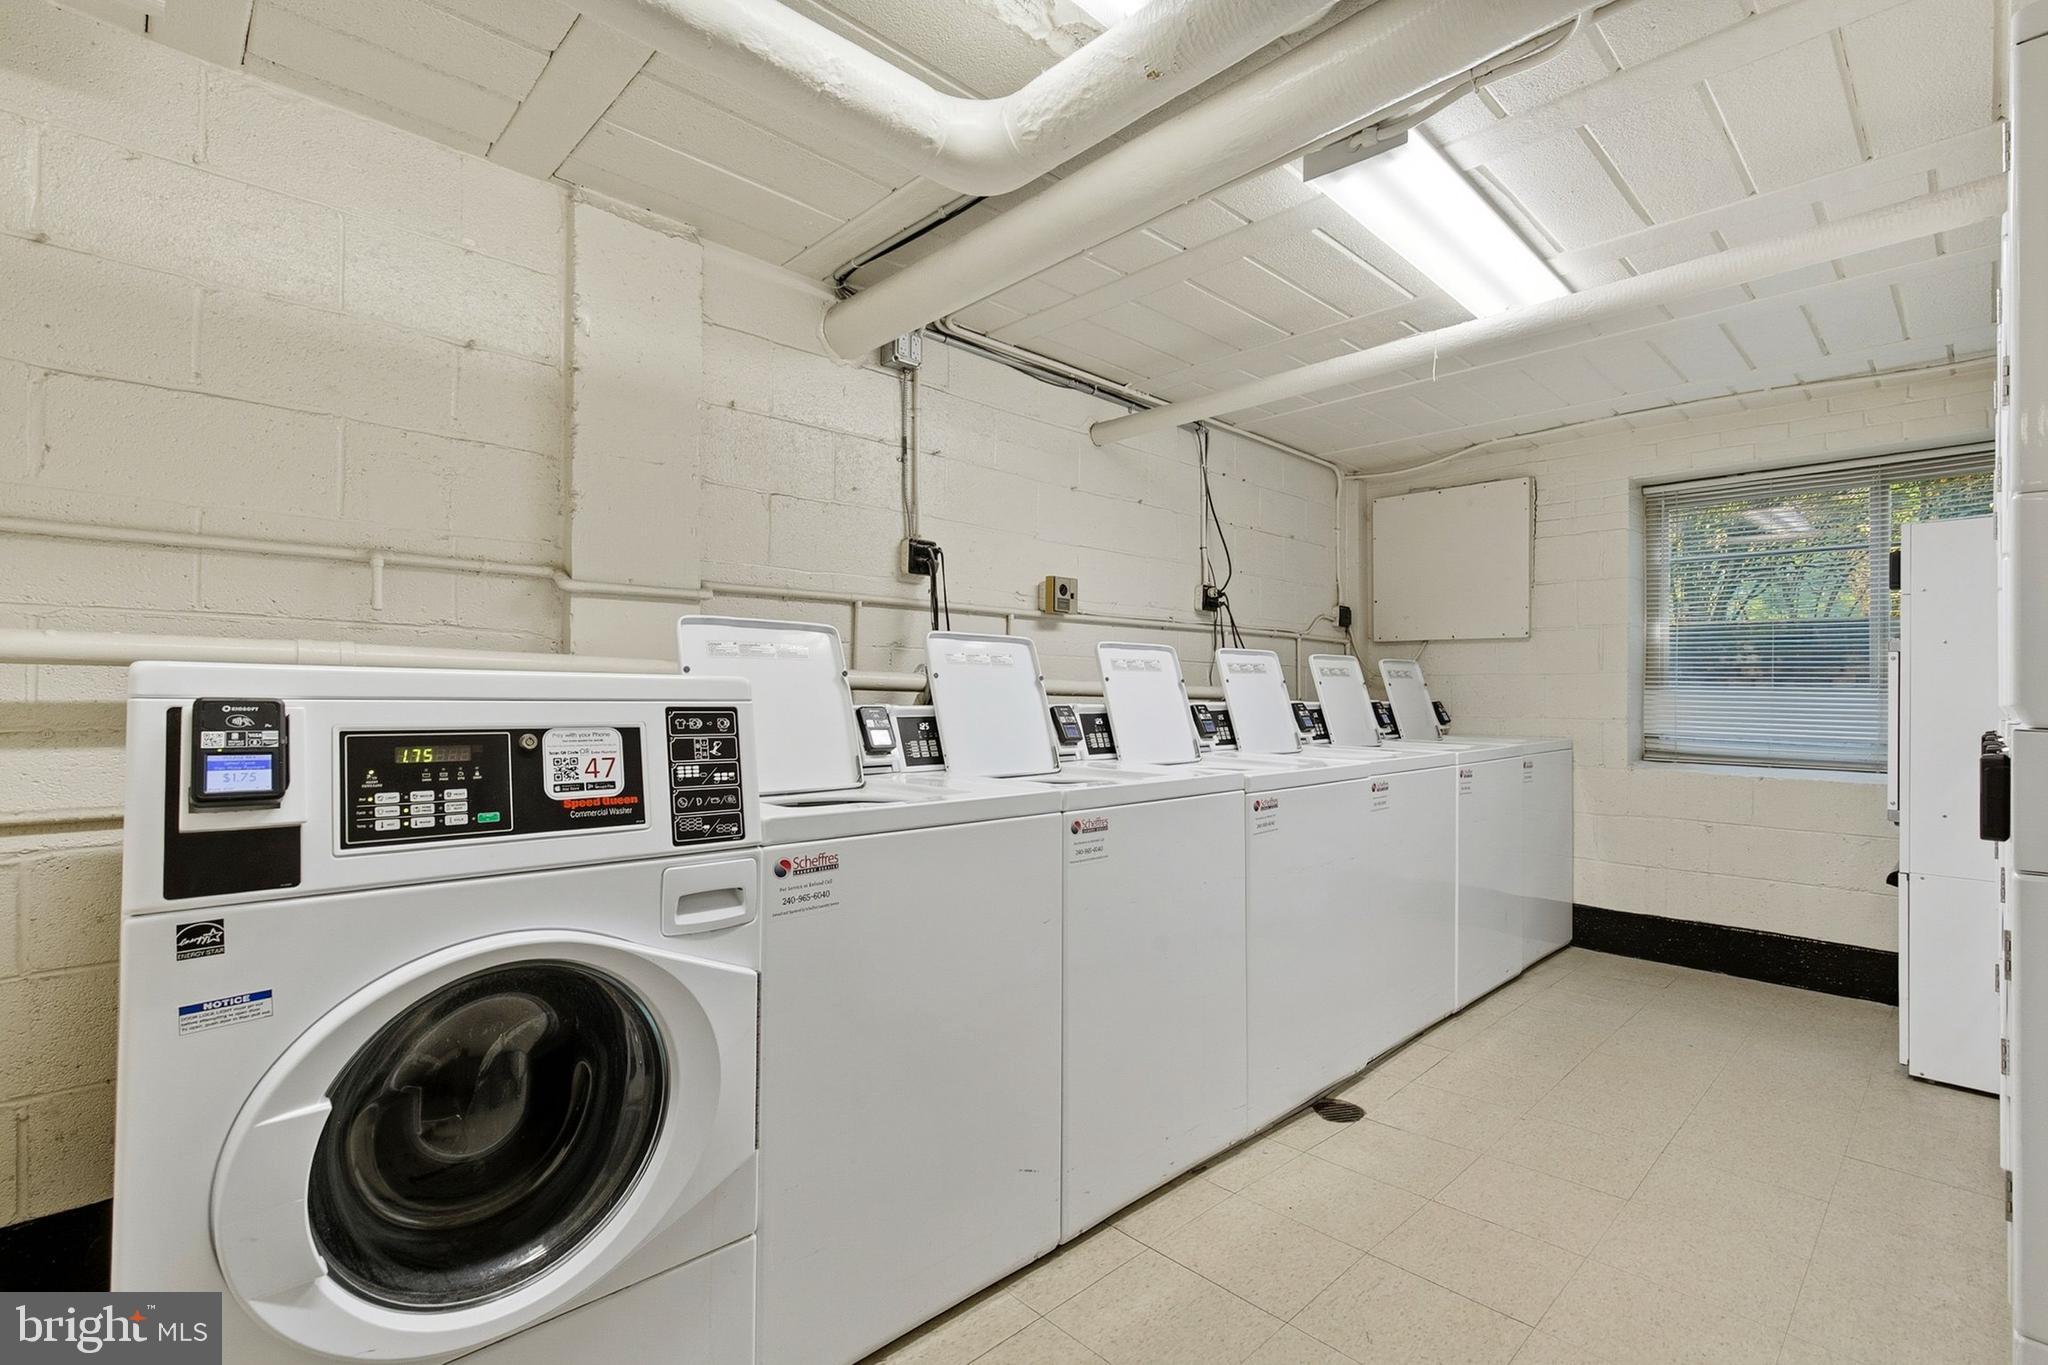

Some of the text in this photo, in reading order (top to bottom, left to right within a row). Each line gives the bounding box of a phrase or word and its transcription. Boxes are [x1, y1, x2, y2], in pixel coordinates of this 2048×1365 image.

[584, 758, 616, 778] 47
[563, 796, 638, 809] Speed Queen
[570, 807, 632, 818] Commercial Washer
[792, 852, 839, 870] Scheffres
[782, 890, 830, 906] 240-965-6040
[178, 948, 224, 960] ENERGY STAR
[203, 994, 250, 1010] NOTICE
